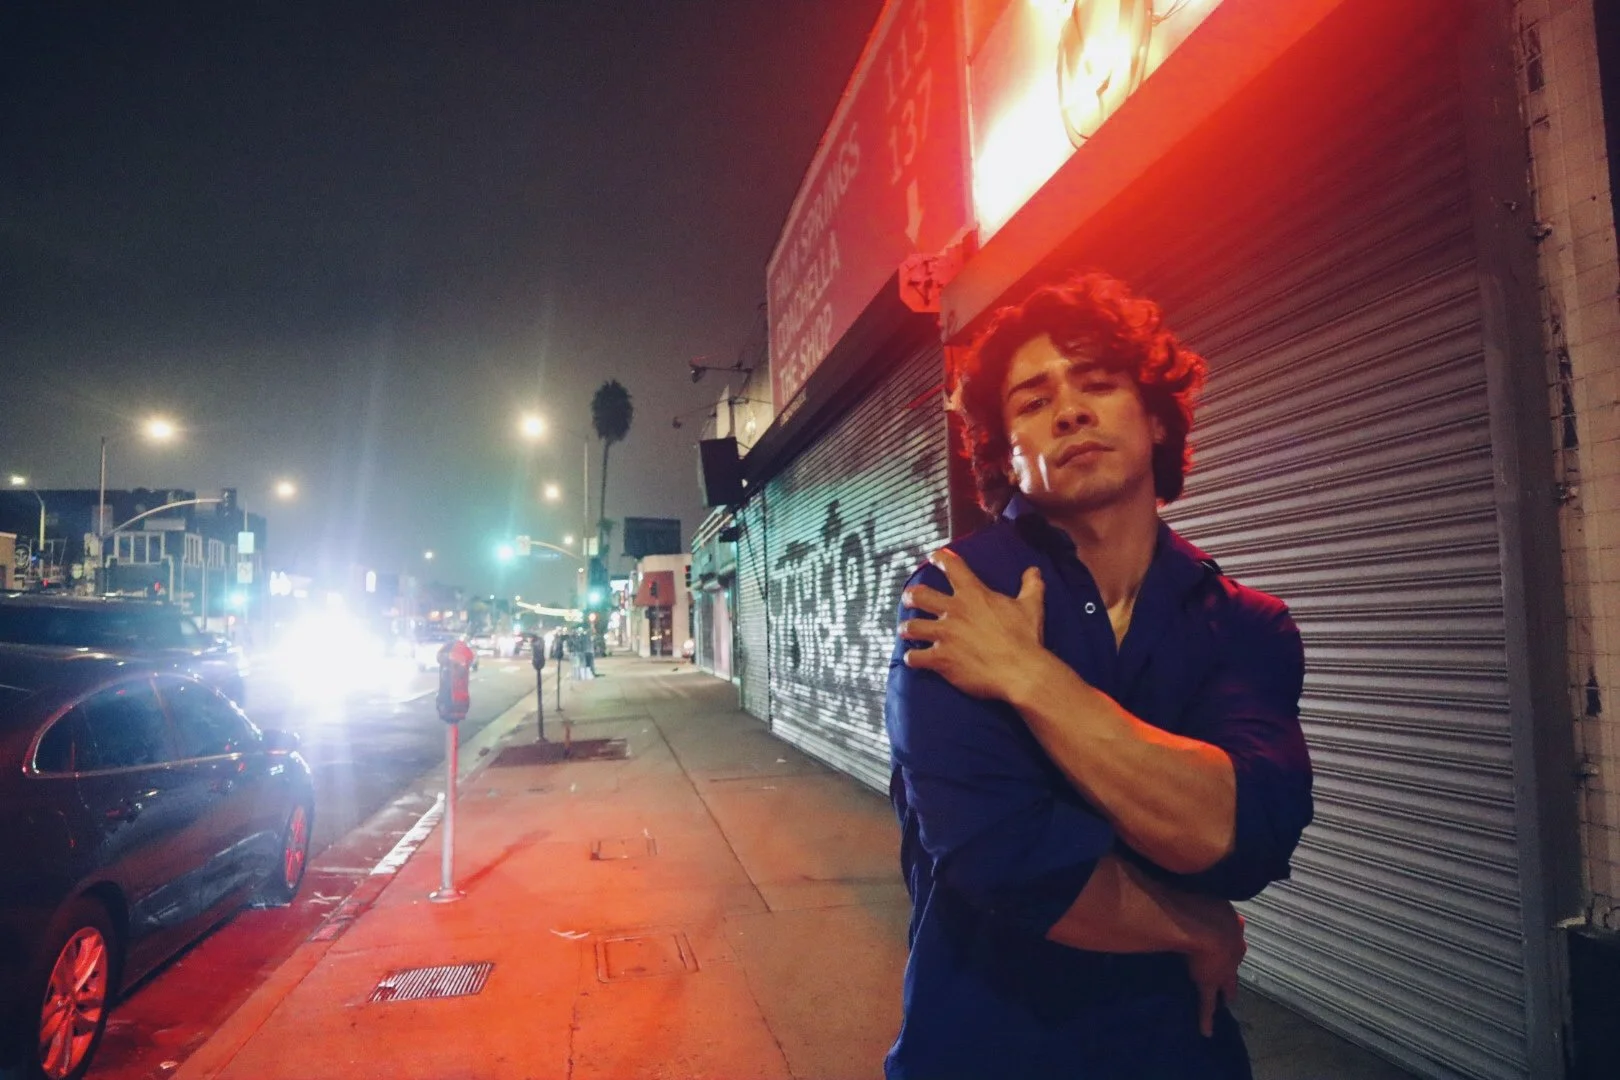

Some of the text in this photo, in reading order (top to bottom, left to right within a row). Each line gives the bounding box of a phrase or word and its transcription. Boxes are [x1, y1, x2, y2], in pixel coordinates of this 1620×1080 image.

[887, 67, 933, 186] 137
[801, 121, 861, 265] SPRINGS
[777, 229, 841, 358] COACHELLA
[779, 348, 799, 406] THE
[800, 302, 833, 382] SHOP
